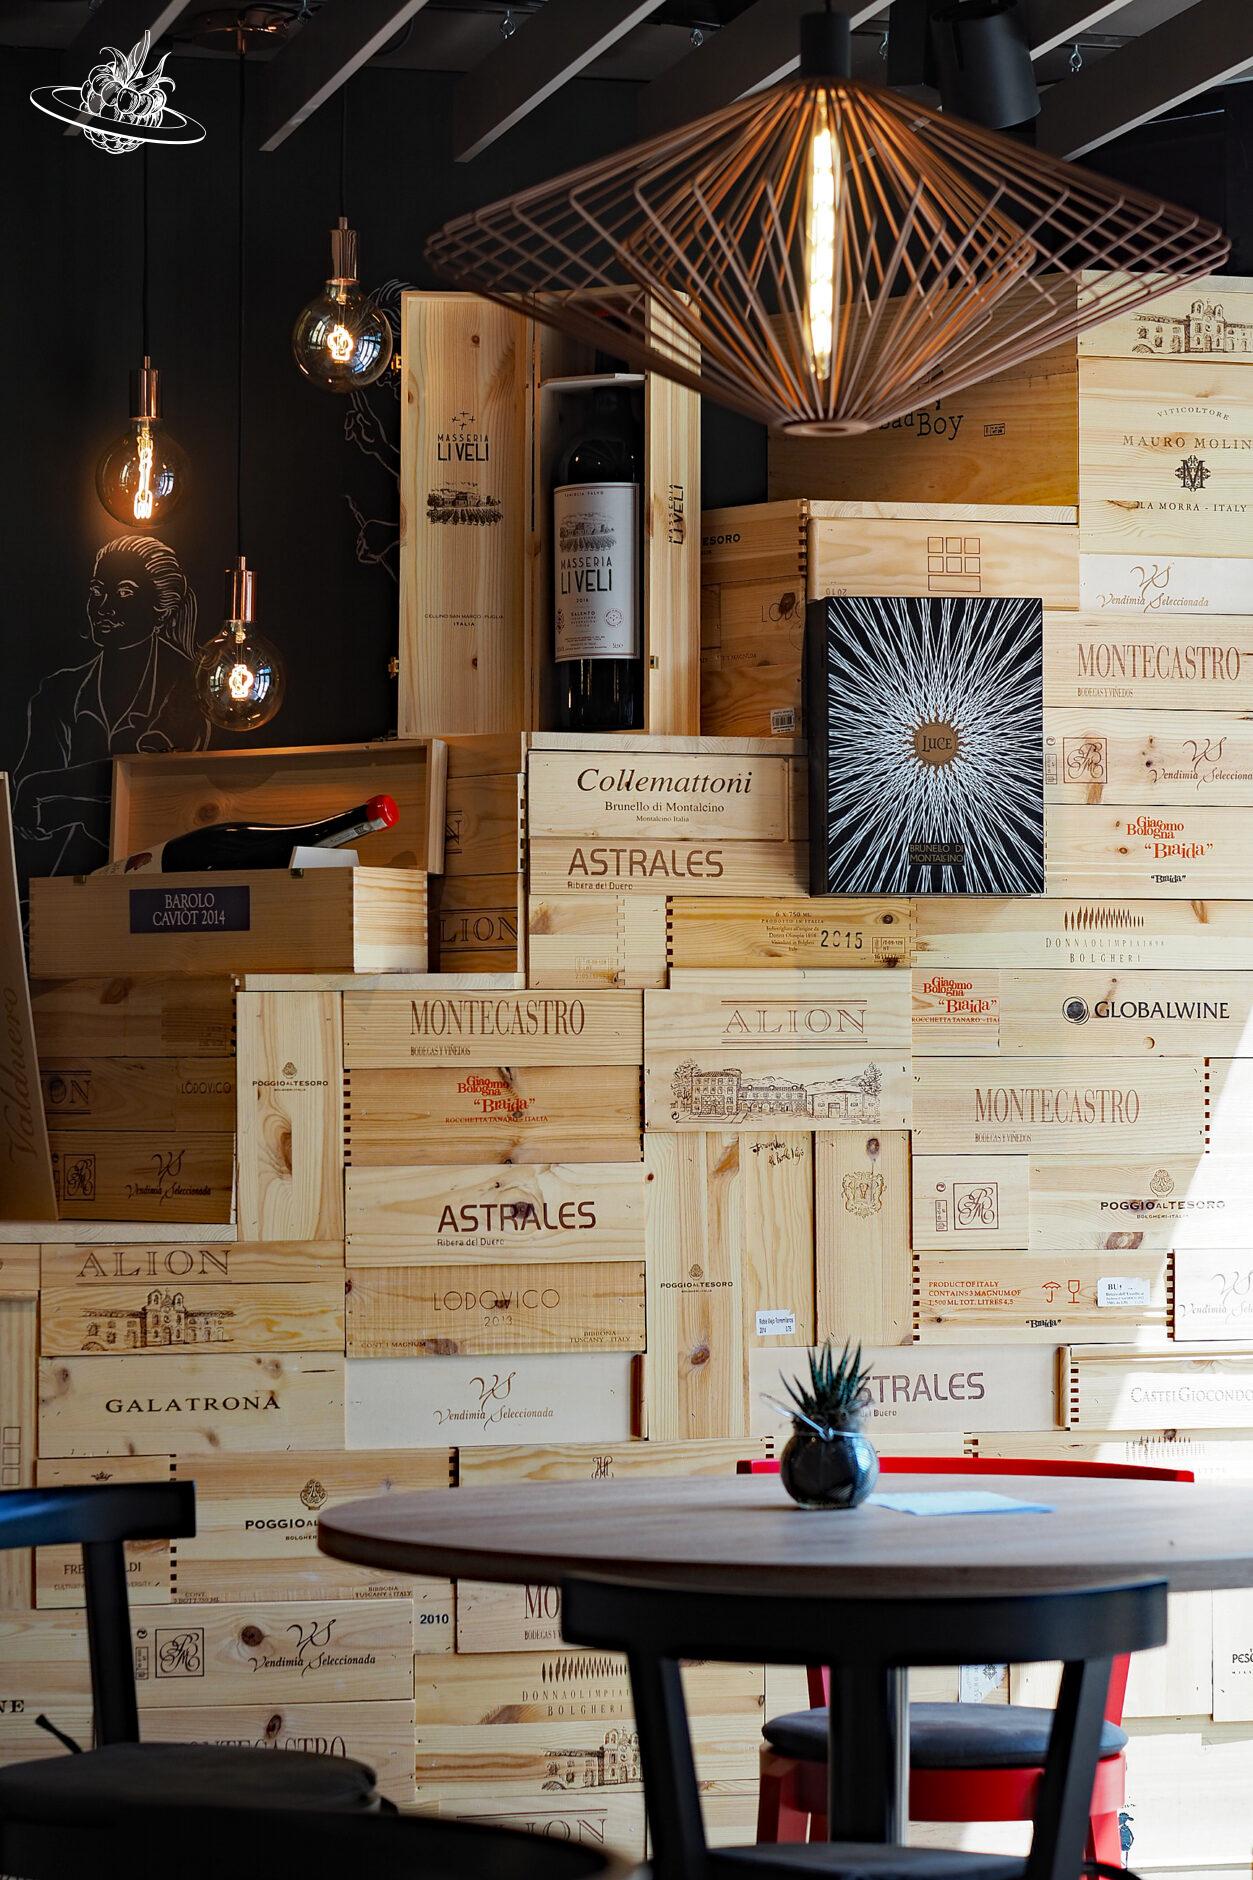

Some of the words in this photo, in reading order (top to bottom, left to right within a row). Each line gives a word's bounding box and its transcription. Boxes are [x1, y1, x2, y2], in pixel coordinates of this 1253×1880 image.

[1157, 406, 1230, 421] VITICOLTORE
[917, 412, 963, 440] Boy
[437, 434, 489, 442] MASSERIA
[1122, 435, 1186, 448] MAURO
[438, 443, 451, 461] LI
[457, 443, 489, 461] VELI
[673, 485, 684, 524] VELI
[1139, 501, 1153, 509] LA
[1159, 502, 1200, 511] MORRA
[1214, 504, 1247, 513] ITALY
[561, 556, 612, 568] MASSERIA
[561, 571, 571, 594] LI
[575, 569, 612, 592] VELI
[1096, 592, 1146, 608] Vendimia
[1144, 592, 1209, 613] Seleccionada
[1077, 643, 1240, 680] MONTECASTRO
[1078, 687, 1103, 696] BODEGAS
[922, 735, 952, 752] LUCE
[577, 768, 753, 794] Collemattoni
[1149, 768, 1198, 784] Vendimia
[605, 802, 650, 812] Brunello
[652, 802, 662, 812] di
[666, 802, 724, 813] Montalcino
[1137, 815, 1184, 831] Giacomo
[1126, 823, 1175, 839] Bologna
[956, 844, 964, 853] DI
[568, 848, 724, 877] ASTRALES
[910, 854, 963, 862] MONTALCINO
[567, 881, 592, 890] Ribera
[595, 881, 607, 890] del
[609, 882, 632, 890] Duero
[165, 893, 215, 909] BAROLO
[202, 910, 226, 926] 2014
[821, 930, 863, 949] 2015
[1070, 953, 1141, 963] BOLGHERI
[923, 983, 964, 996] Bologna
[932, 976, 973, 990] Giacomo
[410, 999, 585, 1035] MONTECASTRO
[1094, 1000, 1230, 1020] GLOBALWINE
[722, 1008, 866, 1034] ALION
[410, 1045, 439, 1056] BODEGAS
[445, 1044, 471, 1056] VIÑEDOS
[181, 1081, 231, 1094] LODOVICO
[457, 1083, 501, 1096] Bologna
[466, 1076, 509, 1089] Giacomo
[975, 1088, 1140, 1124] MONTECASTRO
[975, 1133, 1001, 1143] BODEGAS
[126, 1184, 162, 1198] Vendimia
[160, 1182, 211, 1205] Seleccionada
[1100, 1201, 1155, 1211] POGGIO
[437, 1201, 597, 1233] ASTRALES
[437, 1238, 464, 1247] Ribera
[466, 1238, 478, 1246] del
[480, 1237, 504, 1246] Duero
[76, 1250, 231, 1277] ALION
[433, 1288, 560, 1311] LODOVICO
[484, 1316, 513, 1327] 2013
[106, 1396, 280, 1414] GALATRONA
[433, 1408, 486, 1424] Vendimia
[484, 1405, 554, 1431] Seleccionada
[874, 1409, 897, 1417] Duero
[245, 1519, 305, 1530] POGGIO
[420, 1614, 450, 1624] 2010
[524, 1630, 551, 1640] BODEGAS
[248, 1657, 304, 1673] Vendimia
[301, 1651, 376, 1678] Seleccionada
[547, 1704, 624, 1716] BOLGHERI
